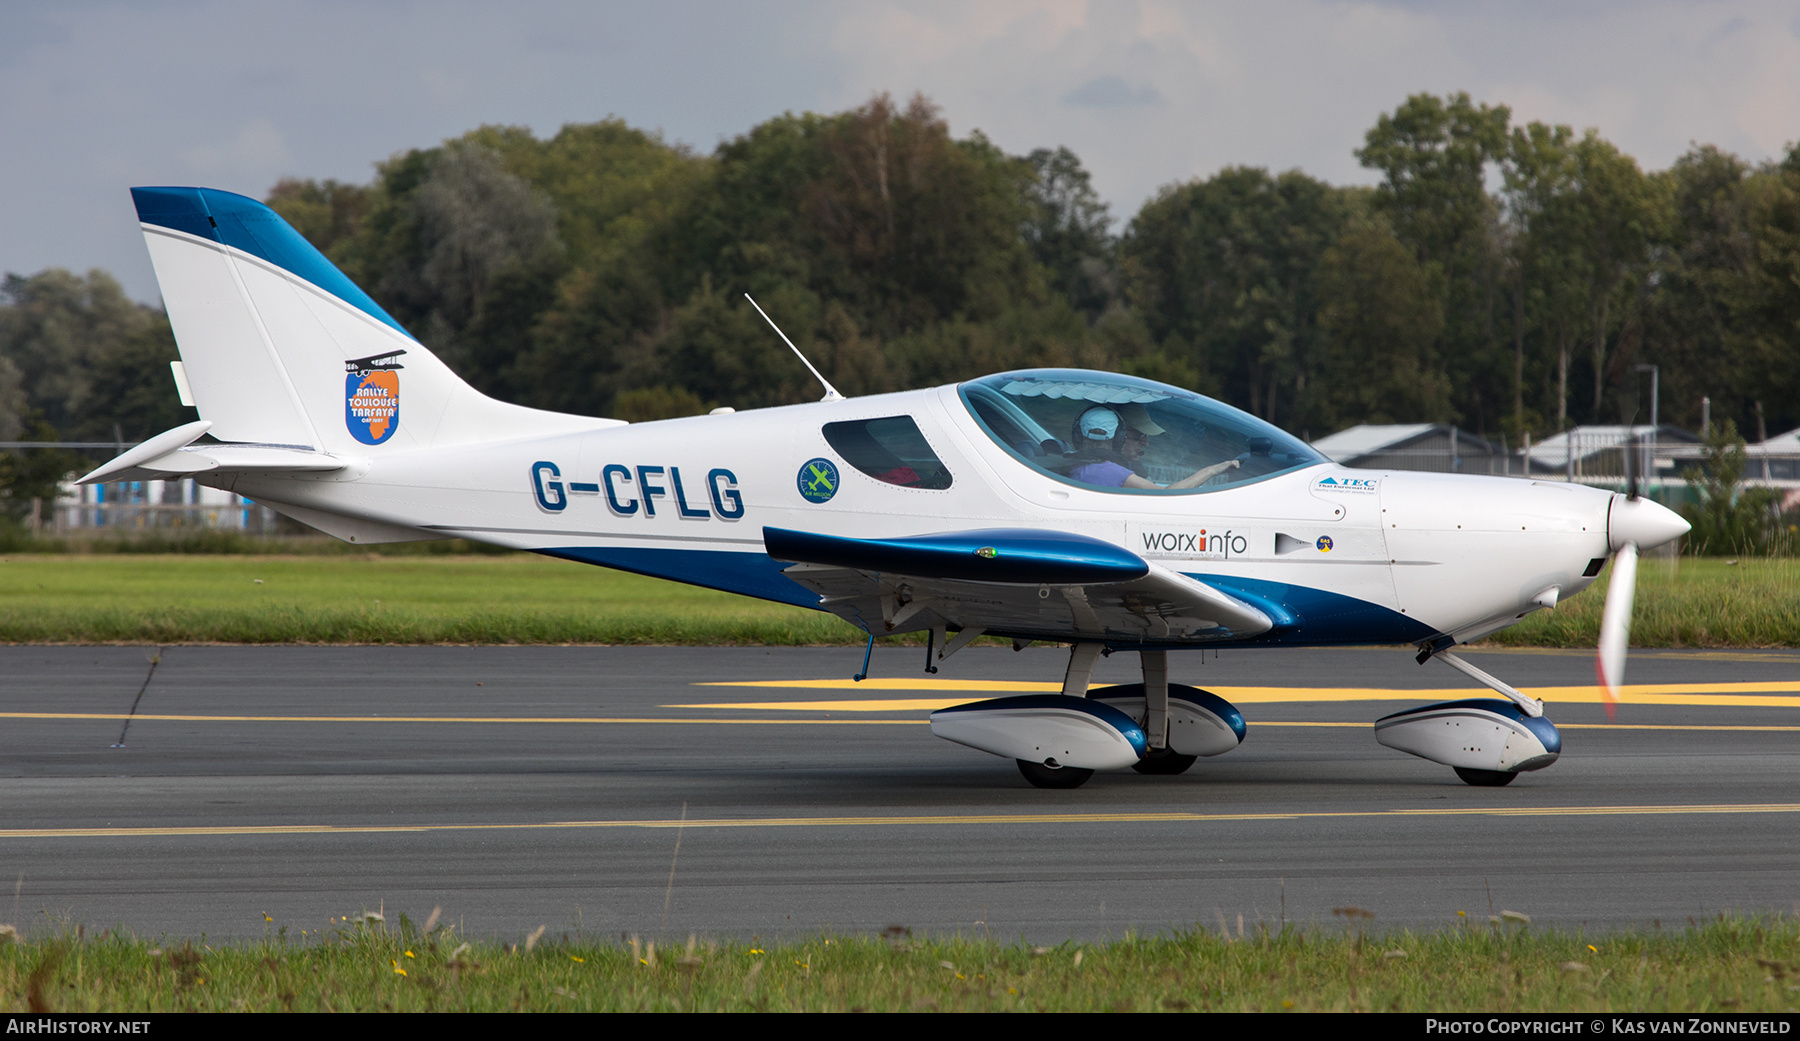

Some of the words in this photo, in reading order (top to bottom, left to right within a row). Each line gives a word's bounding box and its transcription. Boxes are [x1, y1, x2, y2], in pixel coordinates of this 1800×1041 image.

[357, 388, 388, 397] RALLYE
[348, 398, 397, 407] TOULOUSE
[351, 408, 395, 417] TARFAYA
[1341, 478, 1377, 486] TEC
[530, 460, 746, 521] G-CFLG
[1142, 529, 1247, 559] worxinfo
